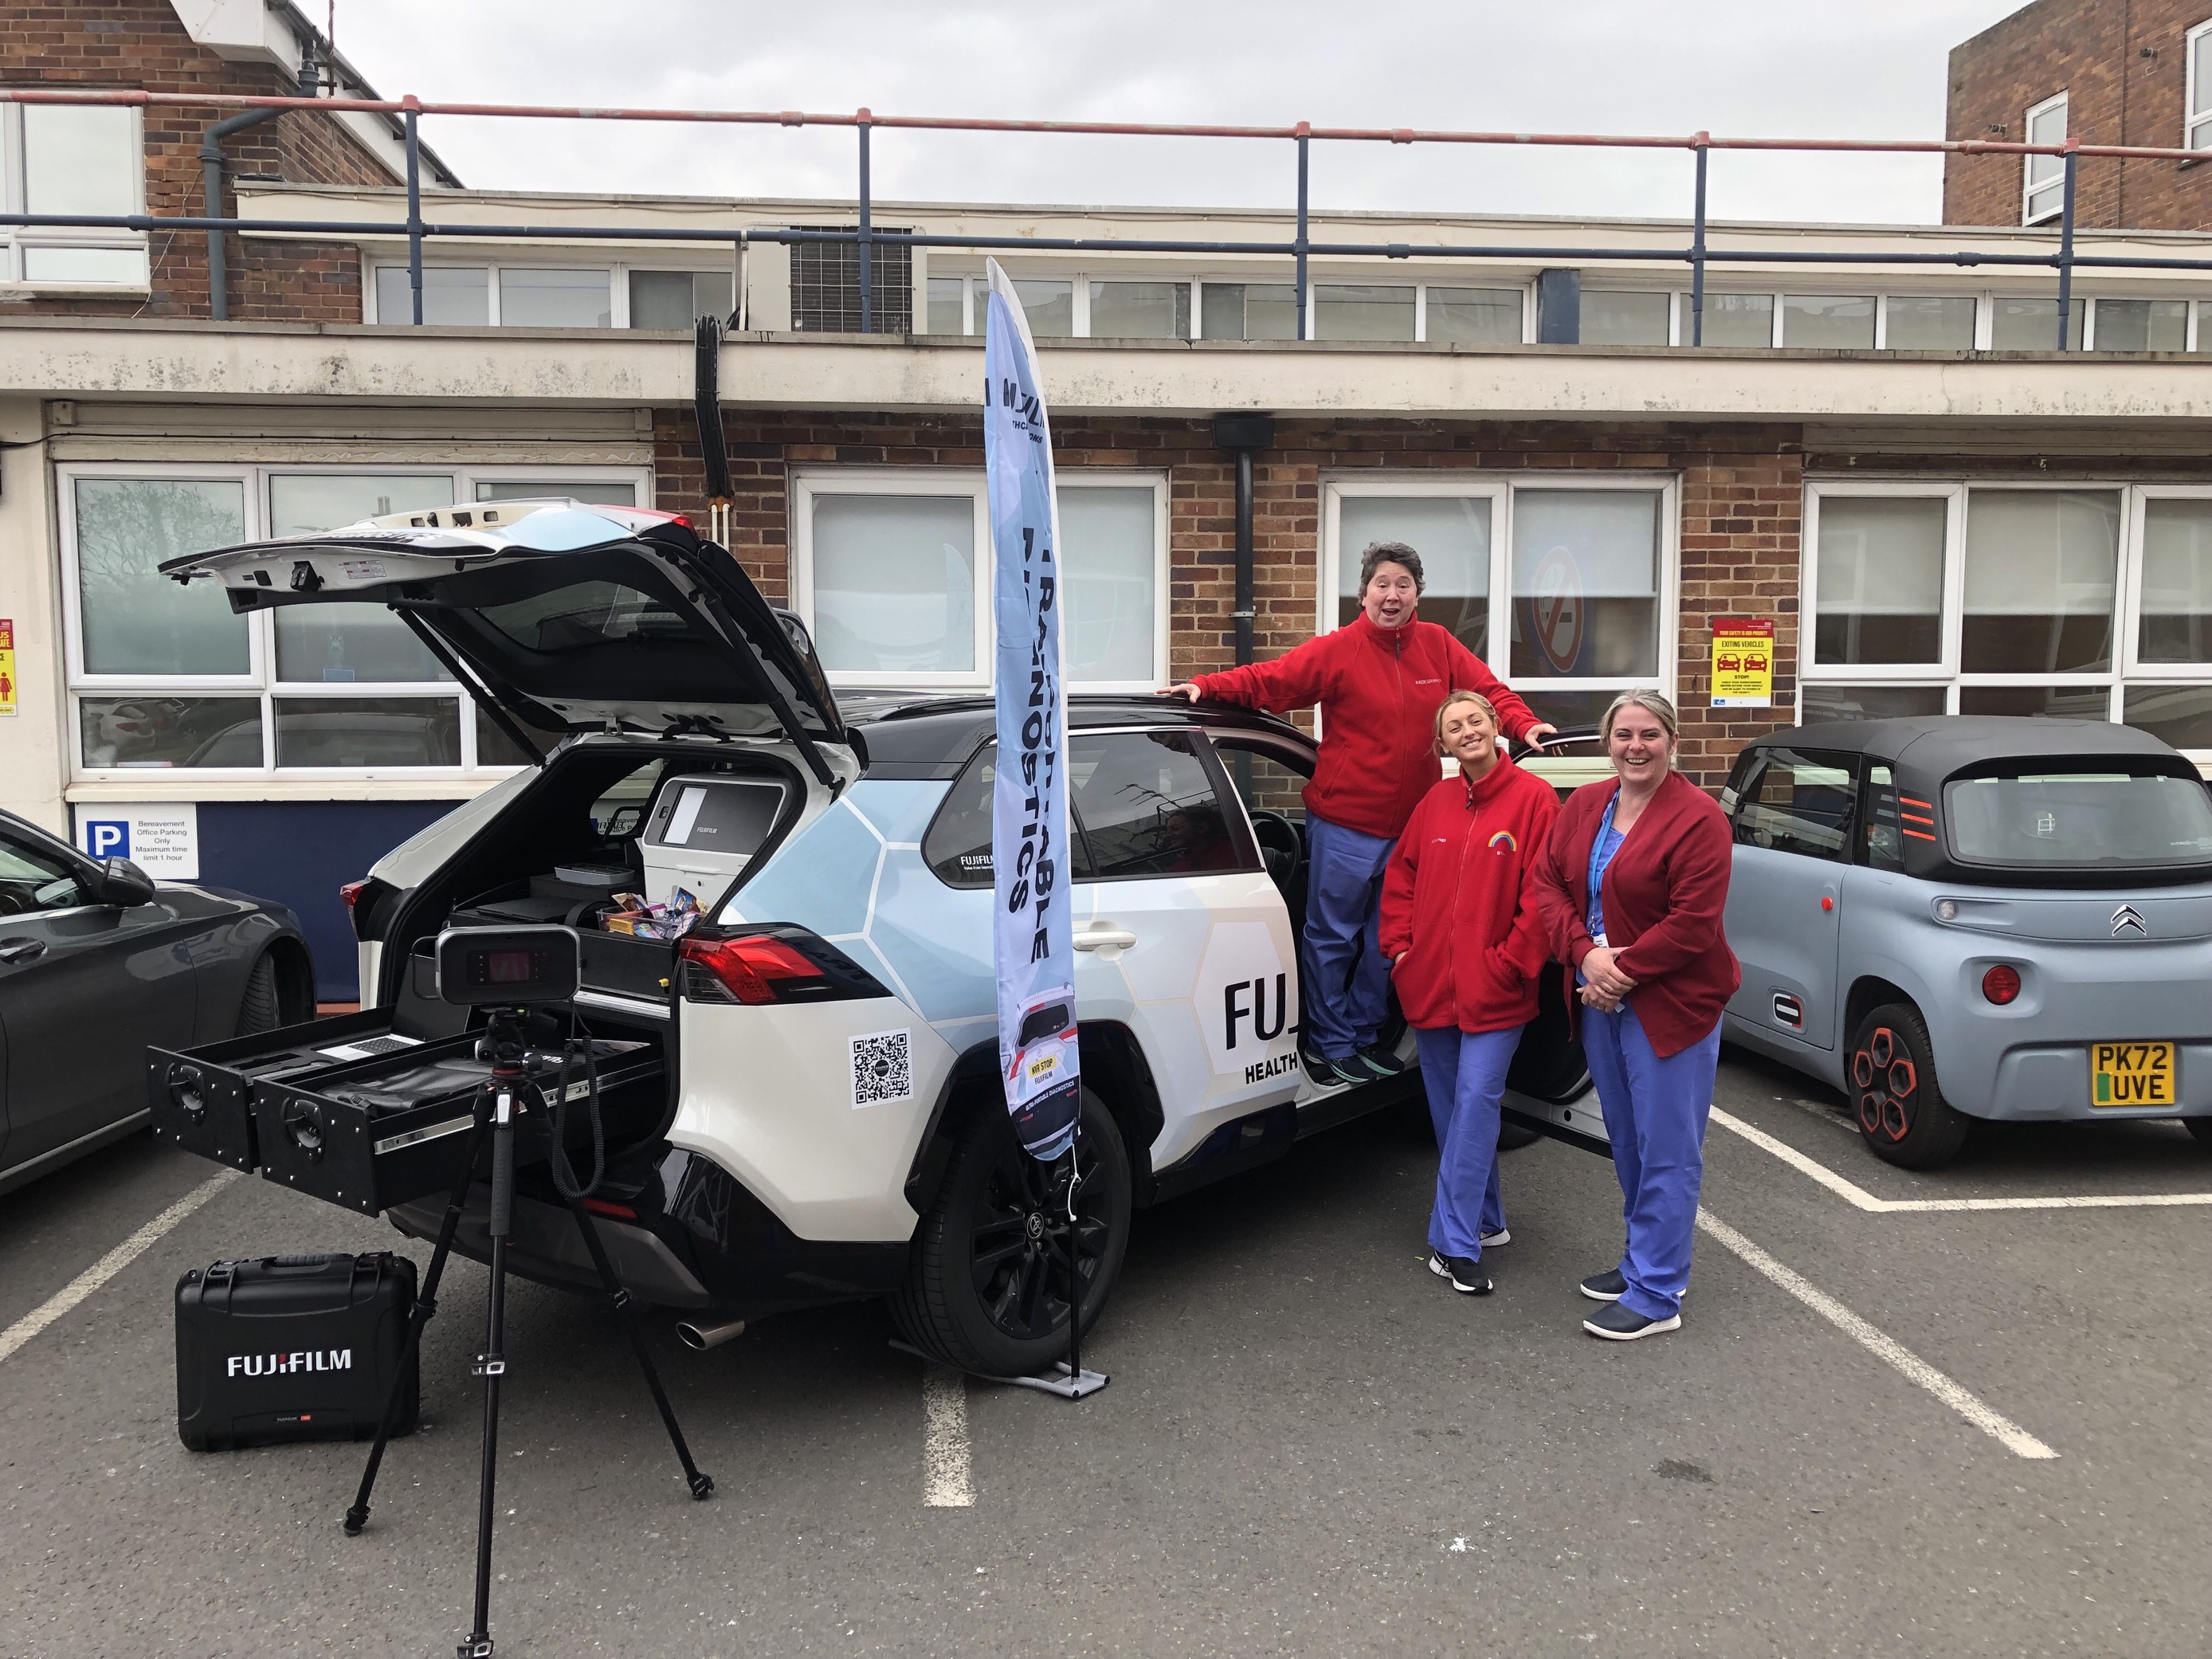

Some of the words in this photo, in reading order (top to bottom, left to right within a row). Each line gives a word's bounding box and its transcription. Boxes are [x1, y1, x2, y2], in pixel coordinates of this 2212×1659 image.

[95, 826, 121, 856] P
[1225, 973, 1299, 1050] FU
[1041, 1058, 1053, 1070] STOP
[1245, 1052, 1298, 1084] HEALTH
[2099, 1045, 2167, 1071] PK72
[1049, 1081, 1075, 1096] DIAGNOSTICS
[2115, 1075, 2164, 1100] UVE
[227, 1349, 351, 1377] FUJIFILM
